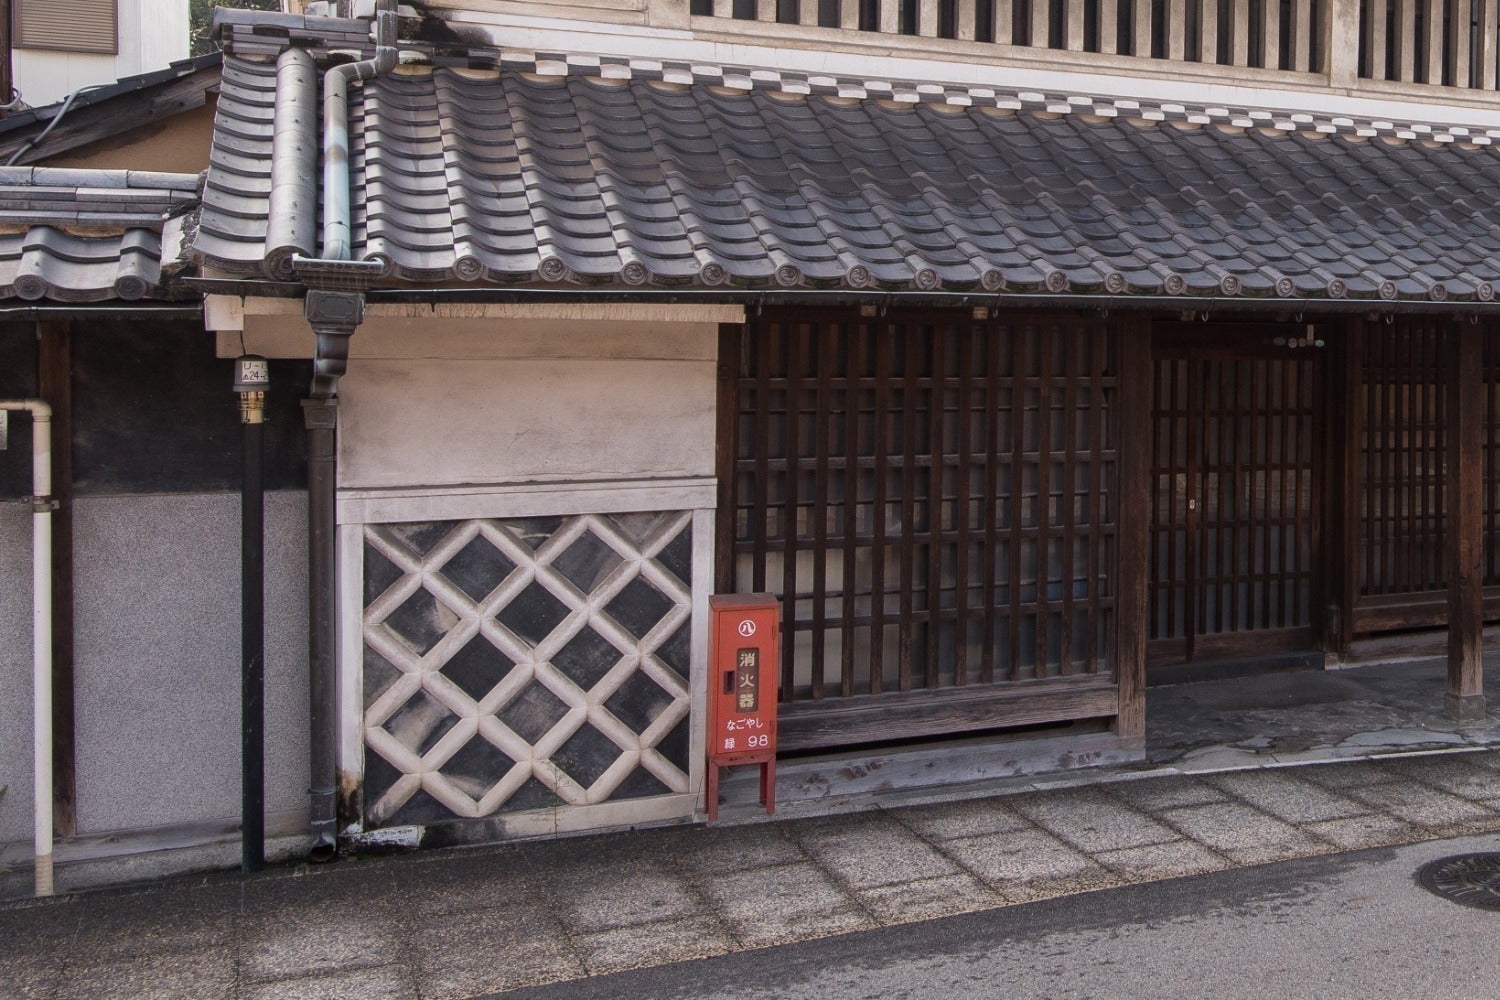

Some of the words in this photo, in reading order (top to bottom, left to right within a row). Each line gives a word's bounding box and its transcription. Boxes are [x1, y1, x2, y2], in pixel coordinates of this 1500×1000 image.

[739, 652, 755, 708] 消火器
[727, 718, 763, 730] なごやし
[748, 735, 768, 747] 98
